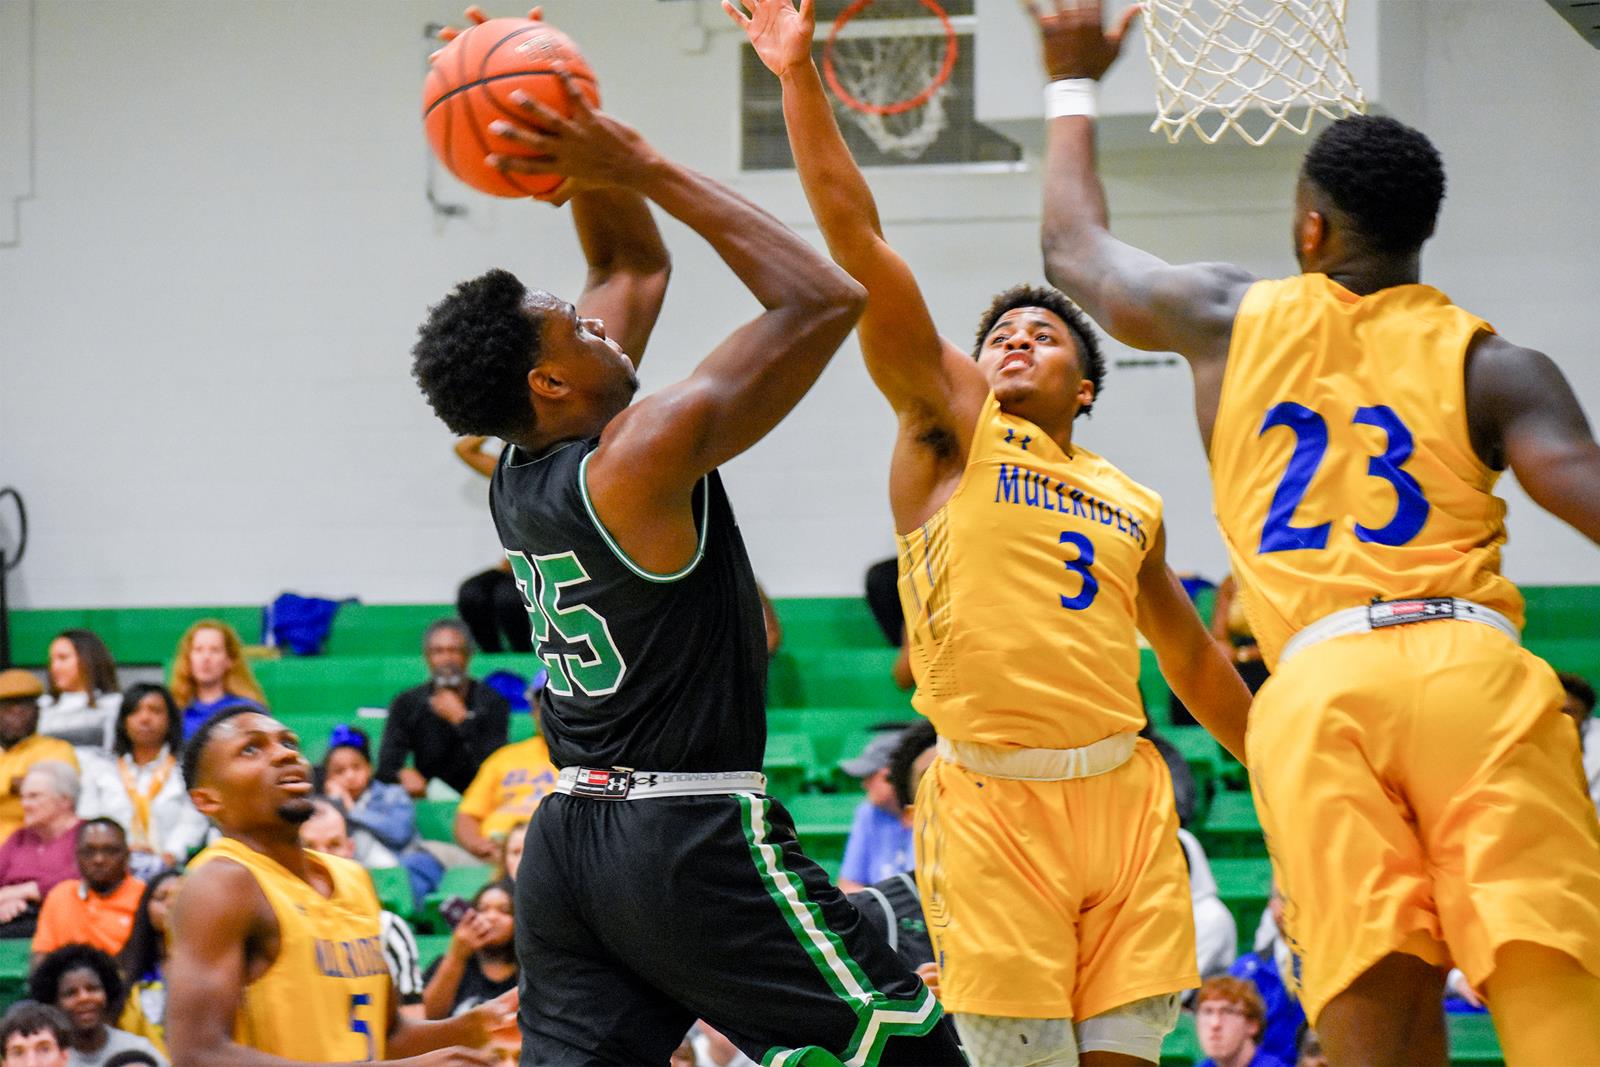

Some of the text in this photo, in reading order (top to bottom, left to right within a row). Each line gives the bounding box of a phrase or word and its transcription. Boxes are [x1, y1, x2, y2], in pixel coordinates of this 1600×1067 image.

[1258, 401, 1430, 554] 23
[504, 548, 627, 697] 25
[1057, 531, 1099, 611] 3
[350, 993, 374, 1063] 5
